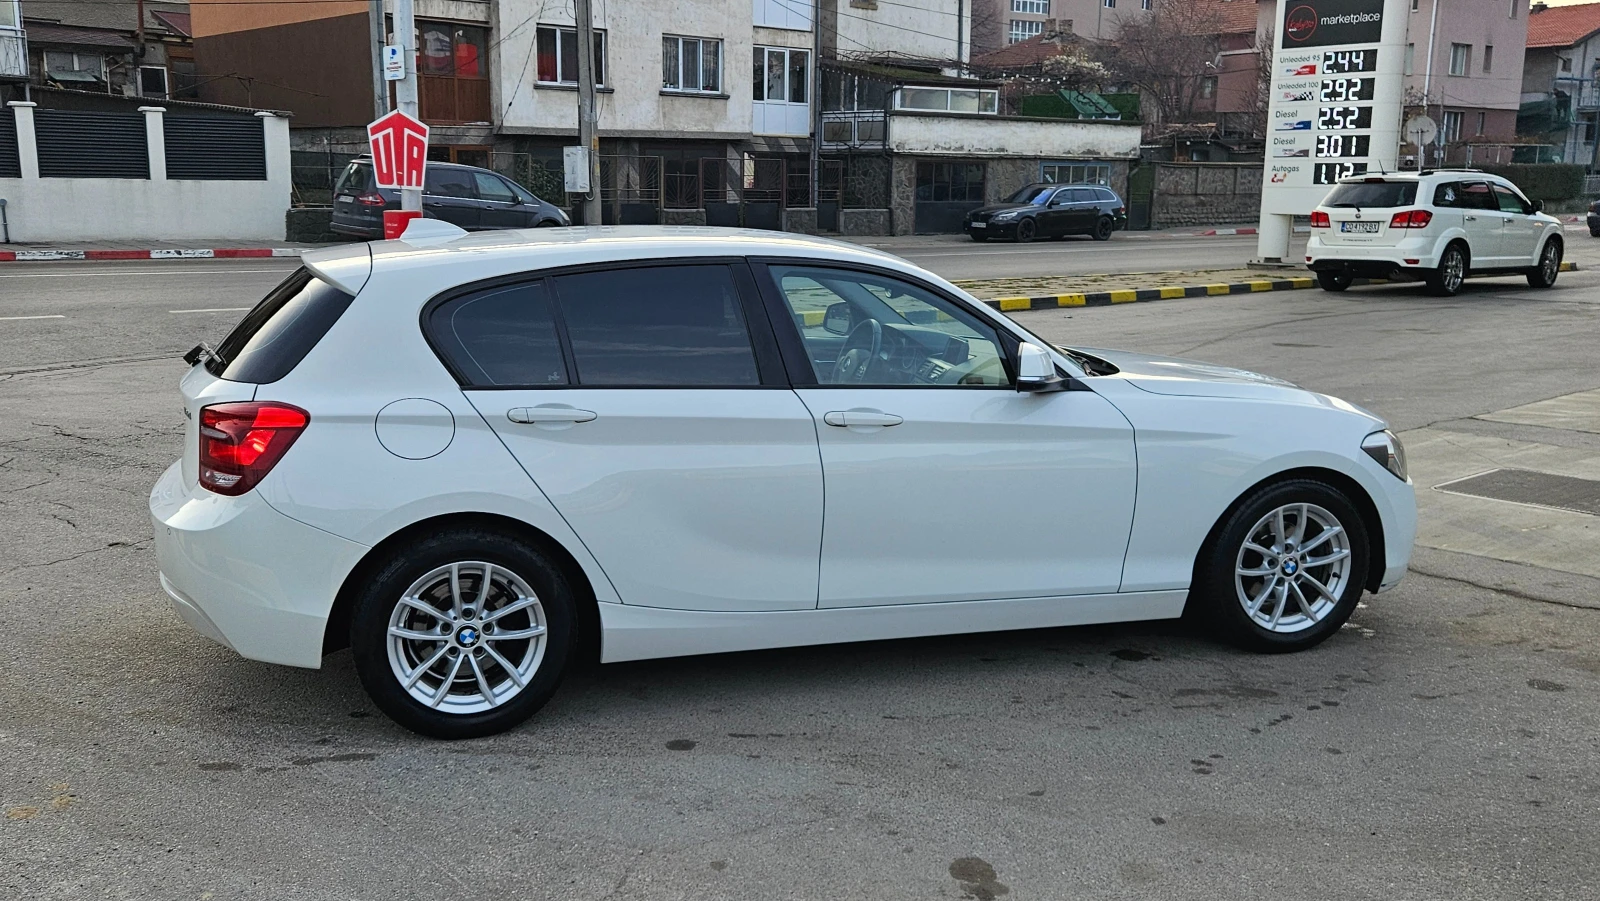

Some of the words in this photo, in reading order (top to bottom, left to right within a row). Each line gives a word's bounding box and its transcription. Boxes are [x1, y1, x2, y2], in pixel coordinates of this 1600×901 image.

[1321, 12, 1380, 25] marketplace
[1280, 55, 1310, 63] Unleaded
[1323, 51, 1363, 73] 2.44
[1278, 80, 1306, 89] Unleaded
[1308, 80, 1319, 88] 100
[1320, 78, 1361, 101] 2.92
[1275, 110, 1297, 118] Diesel
[1318, 107, 1359, 129] 2.52
[1273, 137, 1295, 145] Diesel
[1317, 135, 1357, 157] 3.01
[1271, 165, 1299, 173] Autogas
